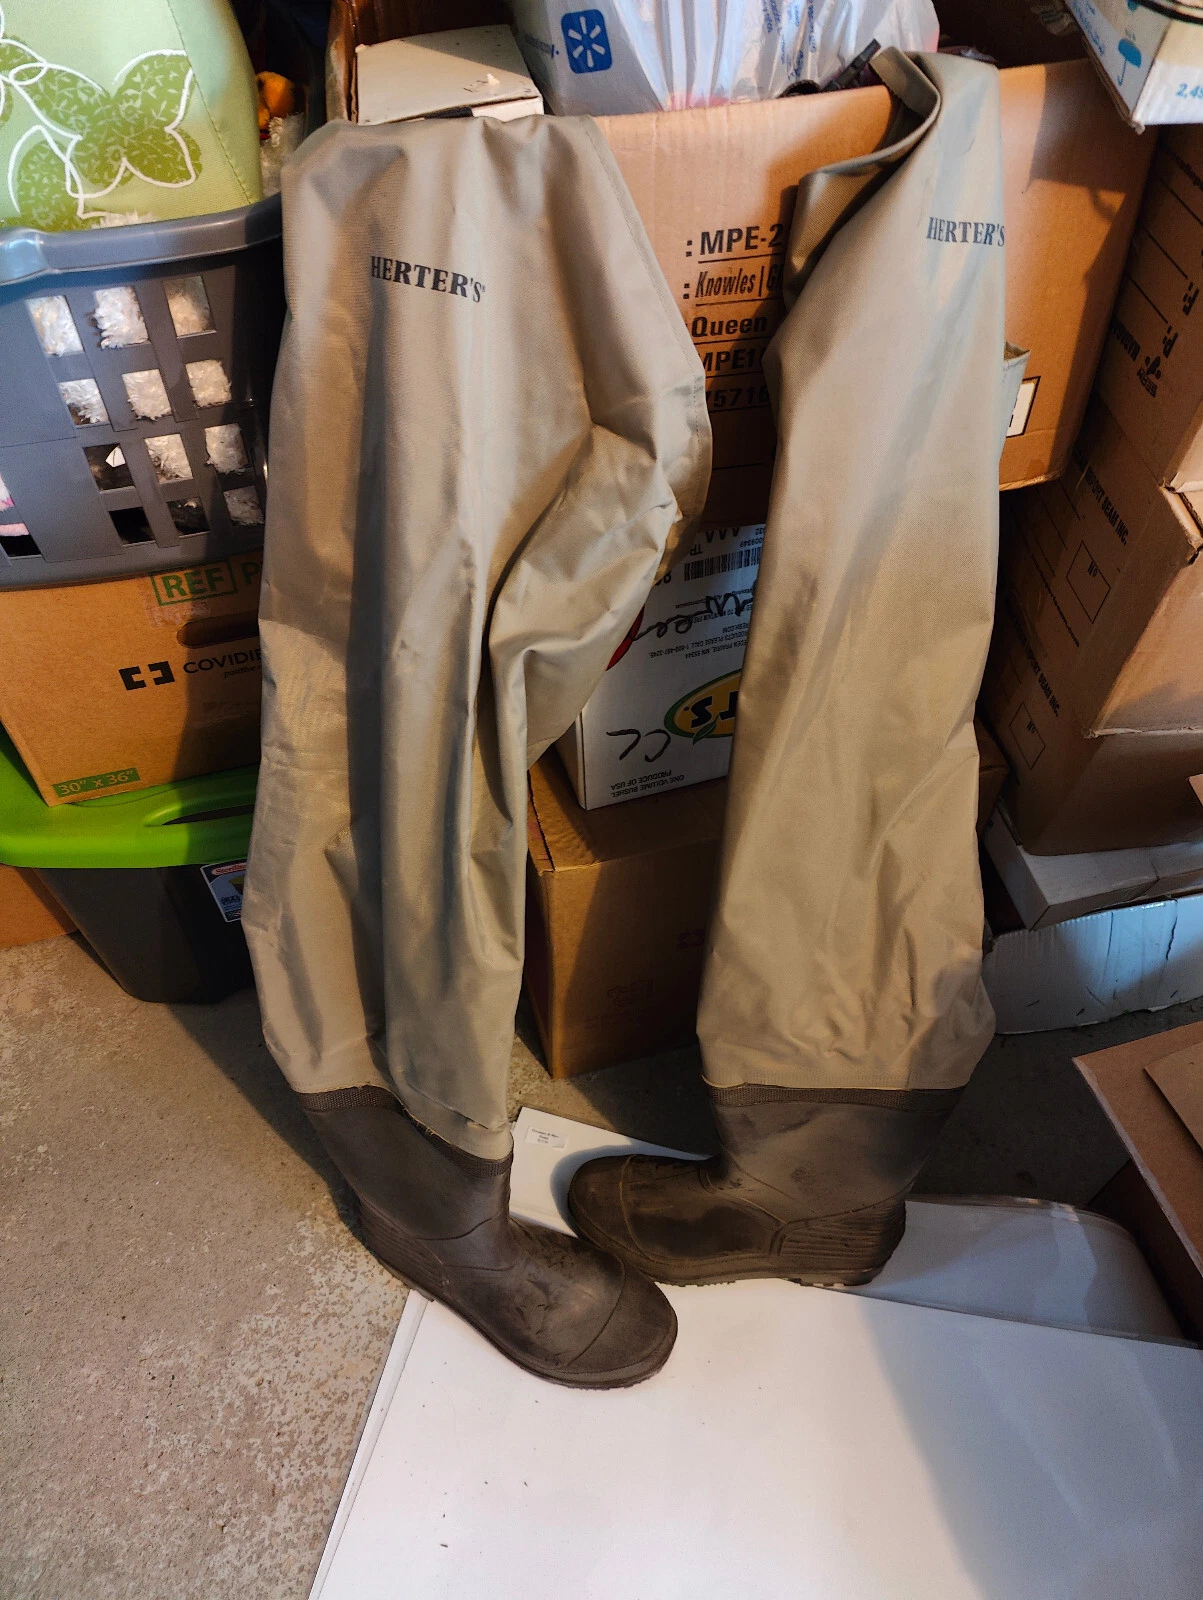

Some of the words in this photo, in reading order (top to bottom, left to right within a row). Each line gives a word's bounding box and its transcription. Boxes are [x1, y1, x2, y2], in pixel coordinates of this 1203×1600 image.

[926, 216, 1005, 247] HERTER'S
[371, 255, 482, 303] HERTER'S
[695, 267, 756, 298] Knowles
[691, 316, 769, 338] Queen
[161, 567, 225, 598] REF
[182, 648, 262, 674] COVIDIE
[627, 778, 637, 786] OF
[637, 769, 672, 784] PRODUCE
[640, 779, 669, 791] VOLUME
[669, 774, 685, 784] ONE
[610, 785, 639, 798] BUSHEL
[611, 781, 626, 791] USA
